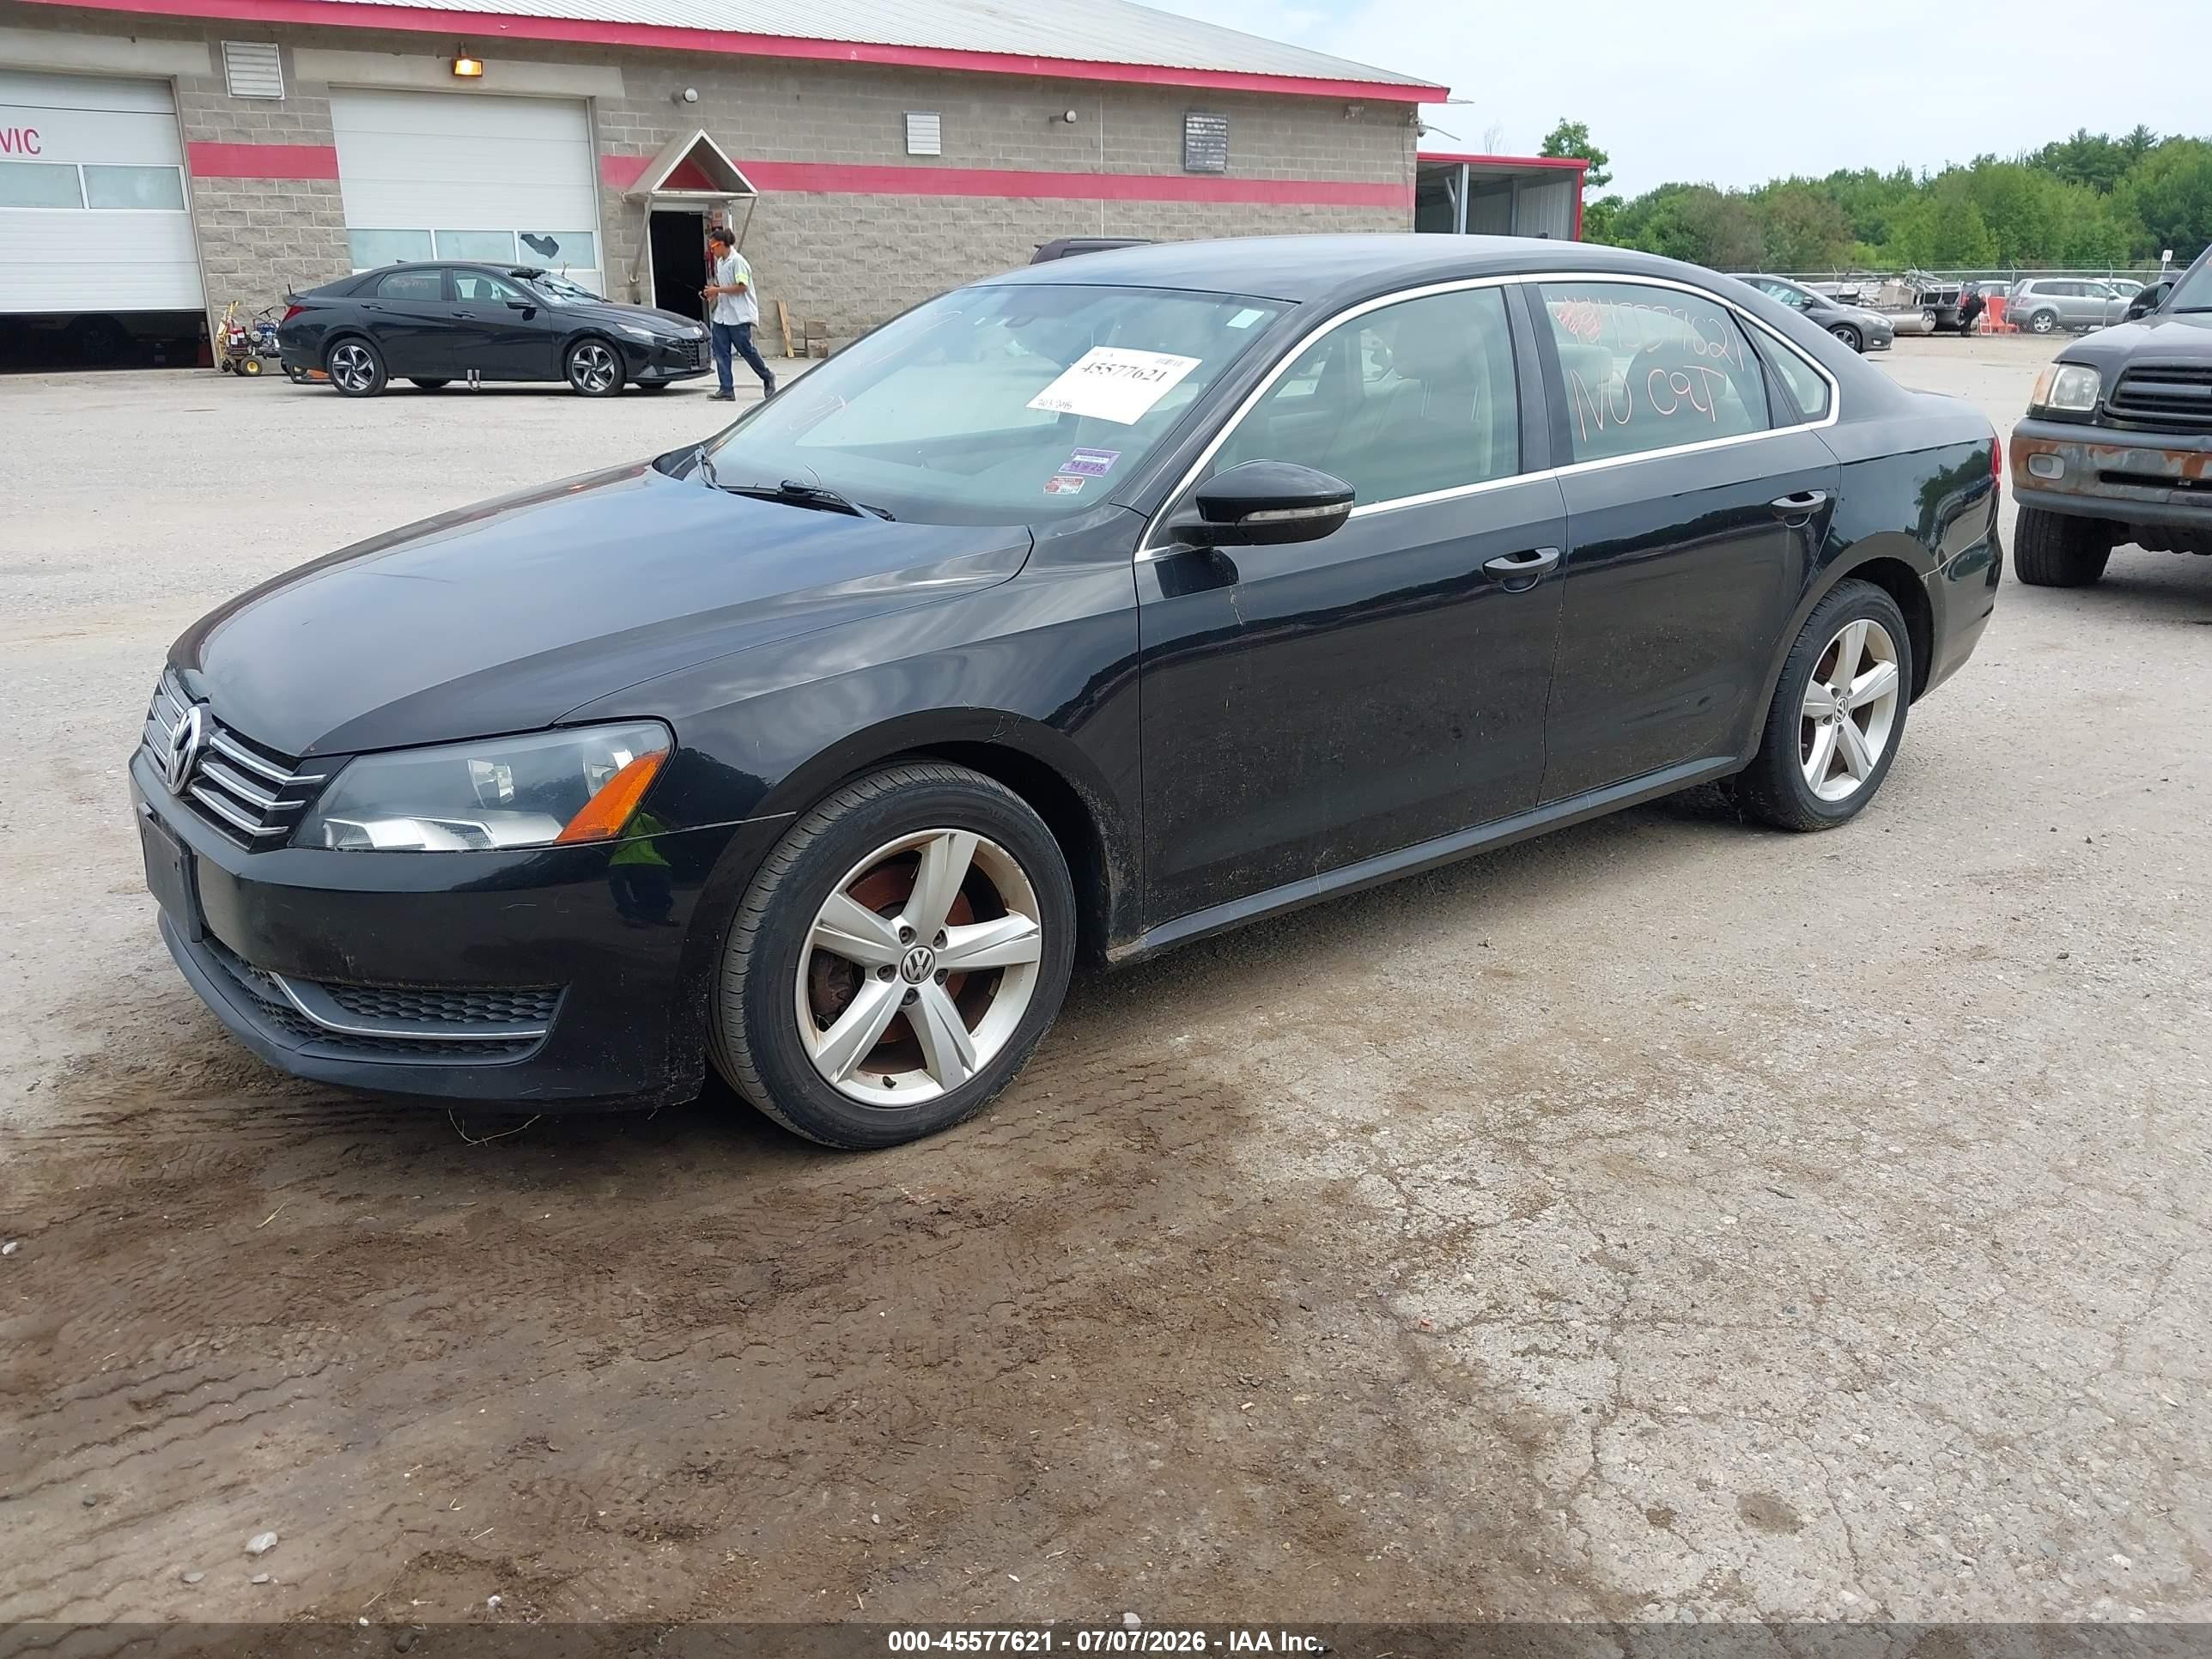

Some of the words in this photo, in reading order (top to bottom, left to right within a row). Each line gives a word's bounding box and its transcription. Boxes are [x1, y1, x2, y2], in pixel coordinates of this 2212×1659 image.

[1081, 362, 1169, 382] 45577621
[1570, 369, 1632, 442] NO
[902, 948, 933, 981] VW
